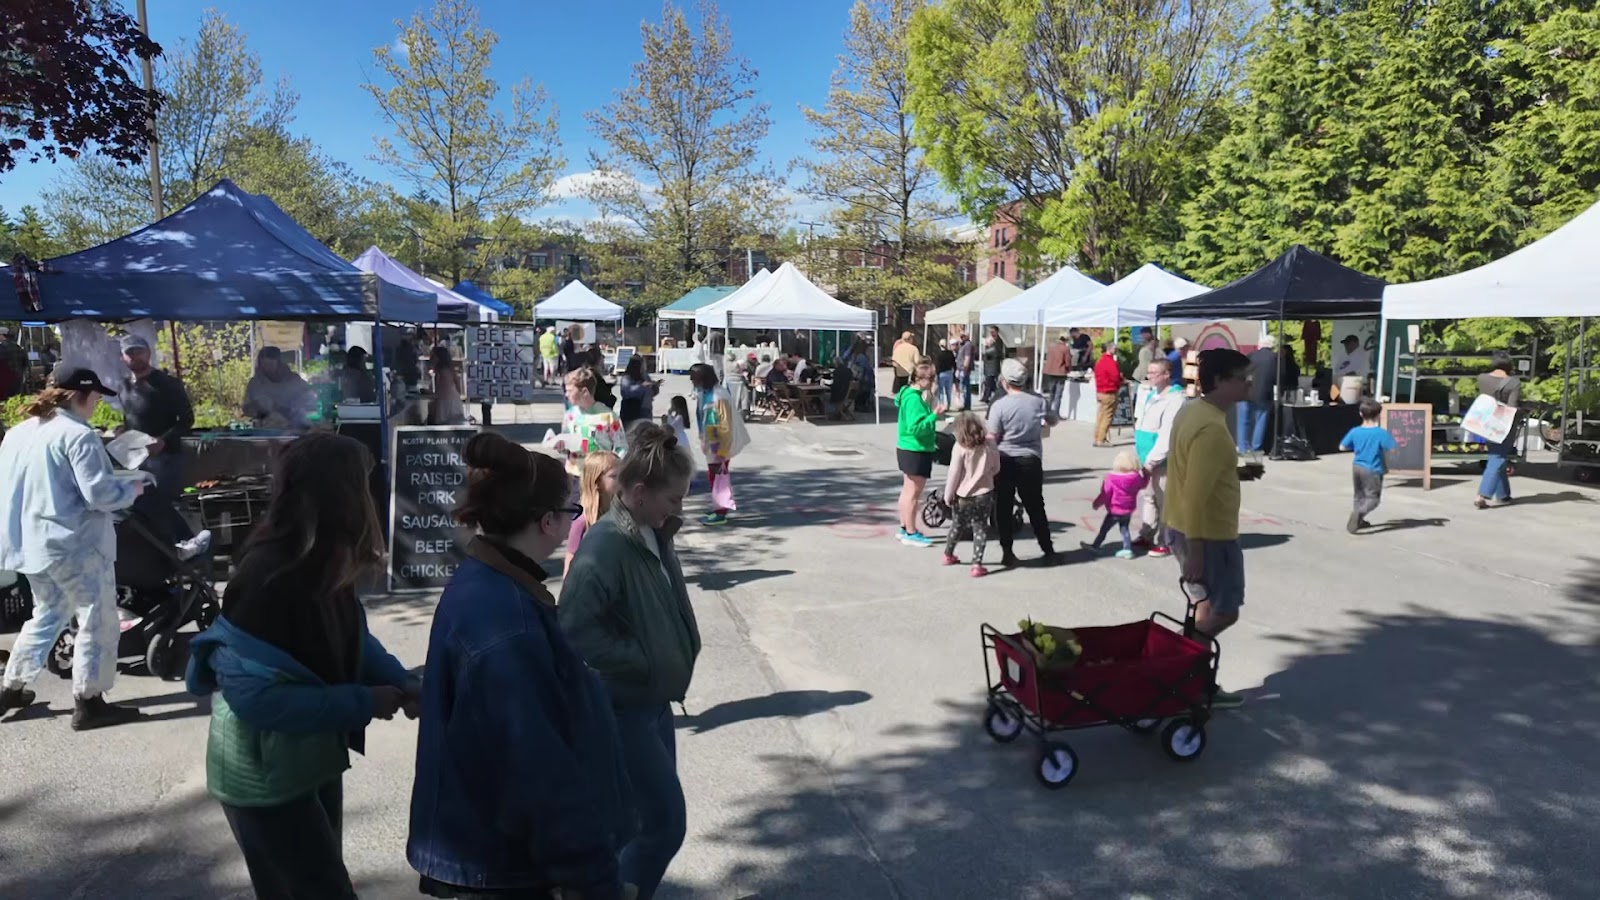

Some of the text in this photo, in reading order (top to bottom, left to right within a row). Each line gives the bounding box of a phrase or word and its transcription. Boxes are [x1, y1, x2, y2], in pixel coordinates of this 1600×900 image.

[477, 328, 523, 342] BEEF
[477, 347, 523, 361] PORK
[467, 365, 529, 380] CHICKEN
[476, 383, 523, 398] EGGS
[402, 438, 424, 446] NORTH
[426, 437, 448, 446] PLAIN
[410, 472, 464, 486] RAISED
[418, 490, 456, 505] PORK
[415, 540, 453, 554] BEEF
[401, 563, 460, 578] CHICKE
